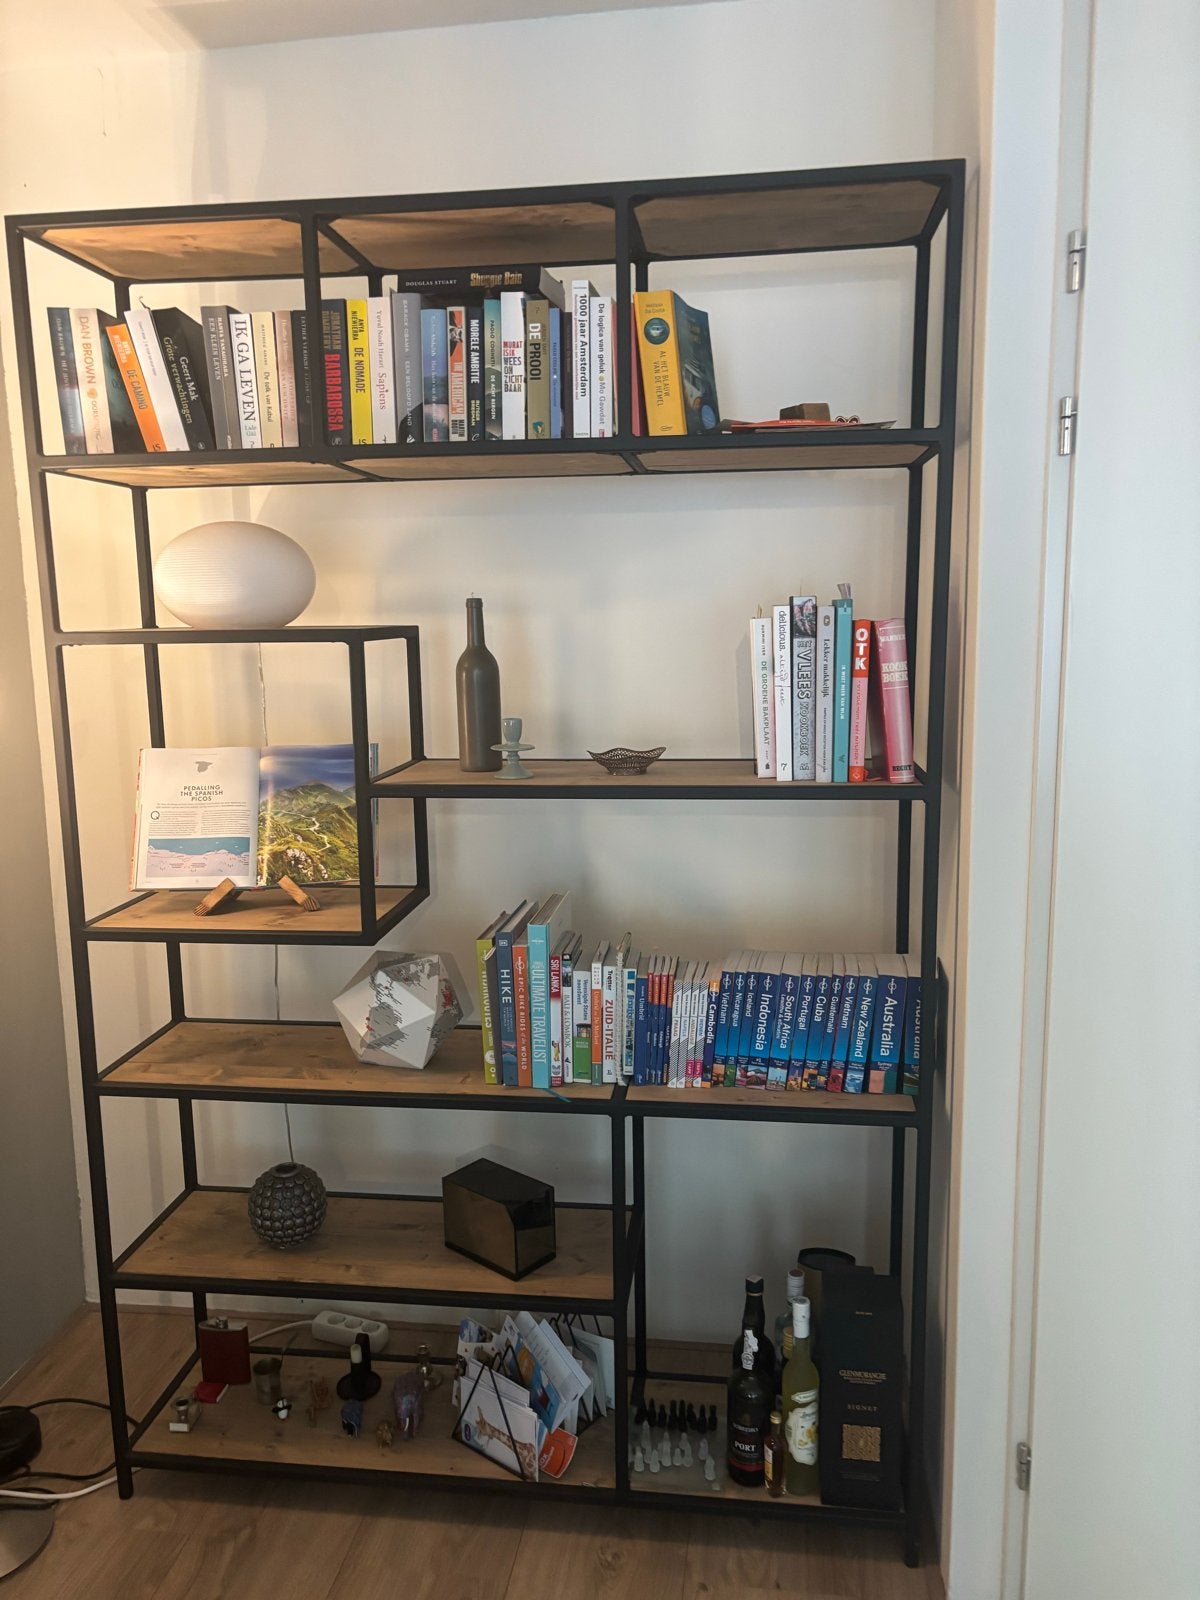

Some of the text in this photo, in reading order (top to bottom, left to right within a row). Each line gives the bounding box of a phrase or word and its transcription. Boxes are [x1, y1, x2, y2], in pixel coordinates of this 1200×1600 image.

[579, 294, 587, 316] 1000
[598, 304, 605, 313] De
[578, 320, 587, 337] jaar
[597, 316, 605, 337] logica
[79, 317, 96, 384] DAN BROWN
[470, 320, 479, 384] MORELE AMBITIE
[503, 340, 522, 348] MURAT
[504, 357, 522, 365] WEES
[529, 323, 541, 380] DE PROOI
[126, 369, 138, 378] DE
[163, 337, 193, 424] Grote verwachtingen
[180, 357, 198, 401] Geert Mak
[234, 320, 256, 421] IK GA LEVEN
[264, 372, 270, 380] De
[354, 348, 365, 393] DE NOMADE
[504, 375, 522, 383] ZICHT
[580, 340, 588, 397] Amsterdam
[597, 354, 605, 374] geluk
[655, 376, 661, 384] DE
[130, 381, 148, 410] CAMINO
[264, 382, 272, 392] tolk
[324, 354, 344, 431] BARBAROSSA
[376, 372, 389, 410] Sapiens
[504, 384, 522, 392] BAAR
[599, 383, 605, 394] Mo
[656, 386, 664, 406] HEMEL
[778, 611, 787, 651] delicious.
[797, 649, 812, 700] VLEES
[821, 664, 830, 698] makkelijk
[761, 661, 770, 745] DE GROENE BAKPLAAT
[799, 702, 809, 756] KOOKBOEK
[500, 970, 512, 1003] HIKE
[532, 970, 545, 1012] ULTIMATE
[550, 960, 559, 992] SRI LANKA
[720, 992, 730, 1024] Vietnam
[732, 992, 742, 1026] Nicaragua
[745, 992, 754, 1017] Iceland
[780, 995, 794, 1048] South Africa
[798, 995, 810, 1030] Portugal
[814, 996, 826, 1021] Cuba
[827, 996, 838, 1033] Guatemala
[841, 997, 853, 1028] Vietnam
[605, 1000, 615, 1060] ZUID-ITALIË
[706, 1004, 716, 1043] Cambodia
[755, 994, 772, 1050] Indonesia
[854, 997, 871, 1057] New Zealand
[880, 997, 897, 1056] Australia
[533, 1016, 546, 1063] TRAVELIST
[734, 1440, 756, 1452] PORT
